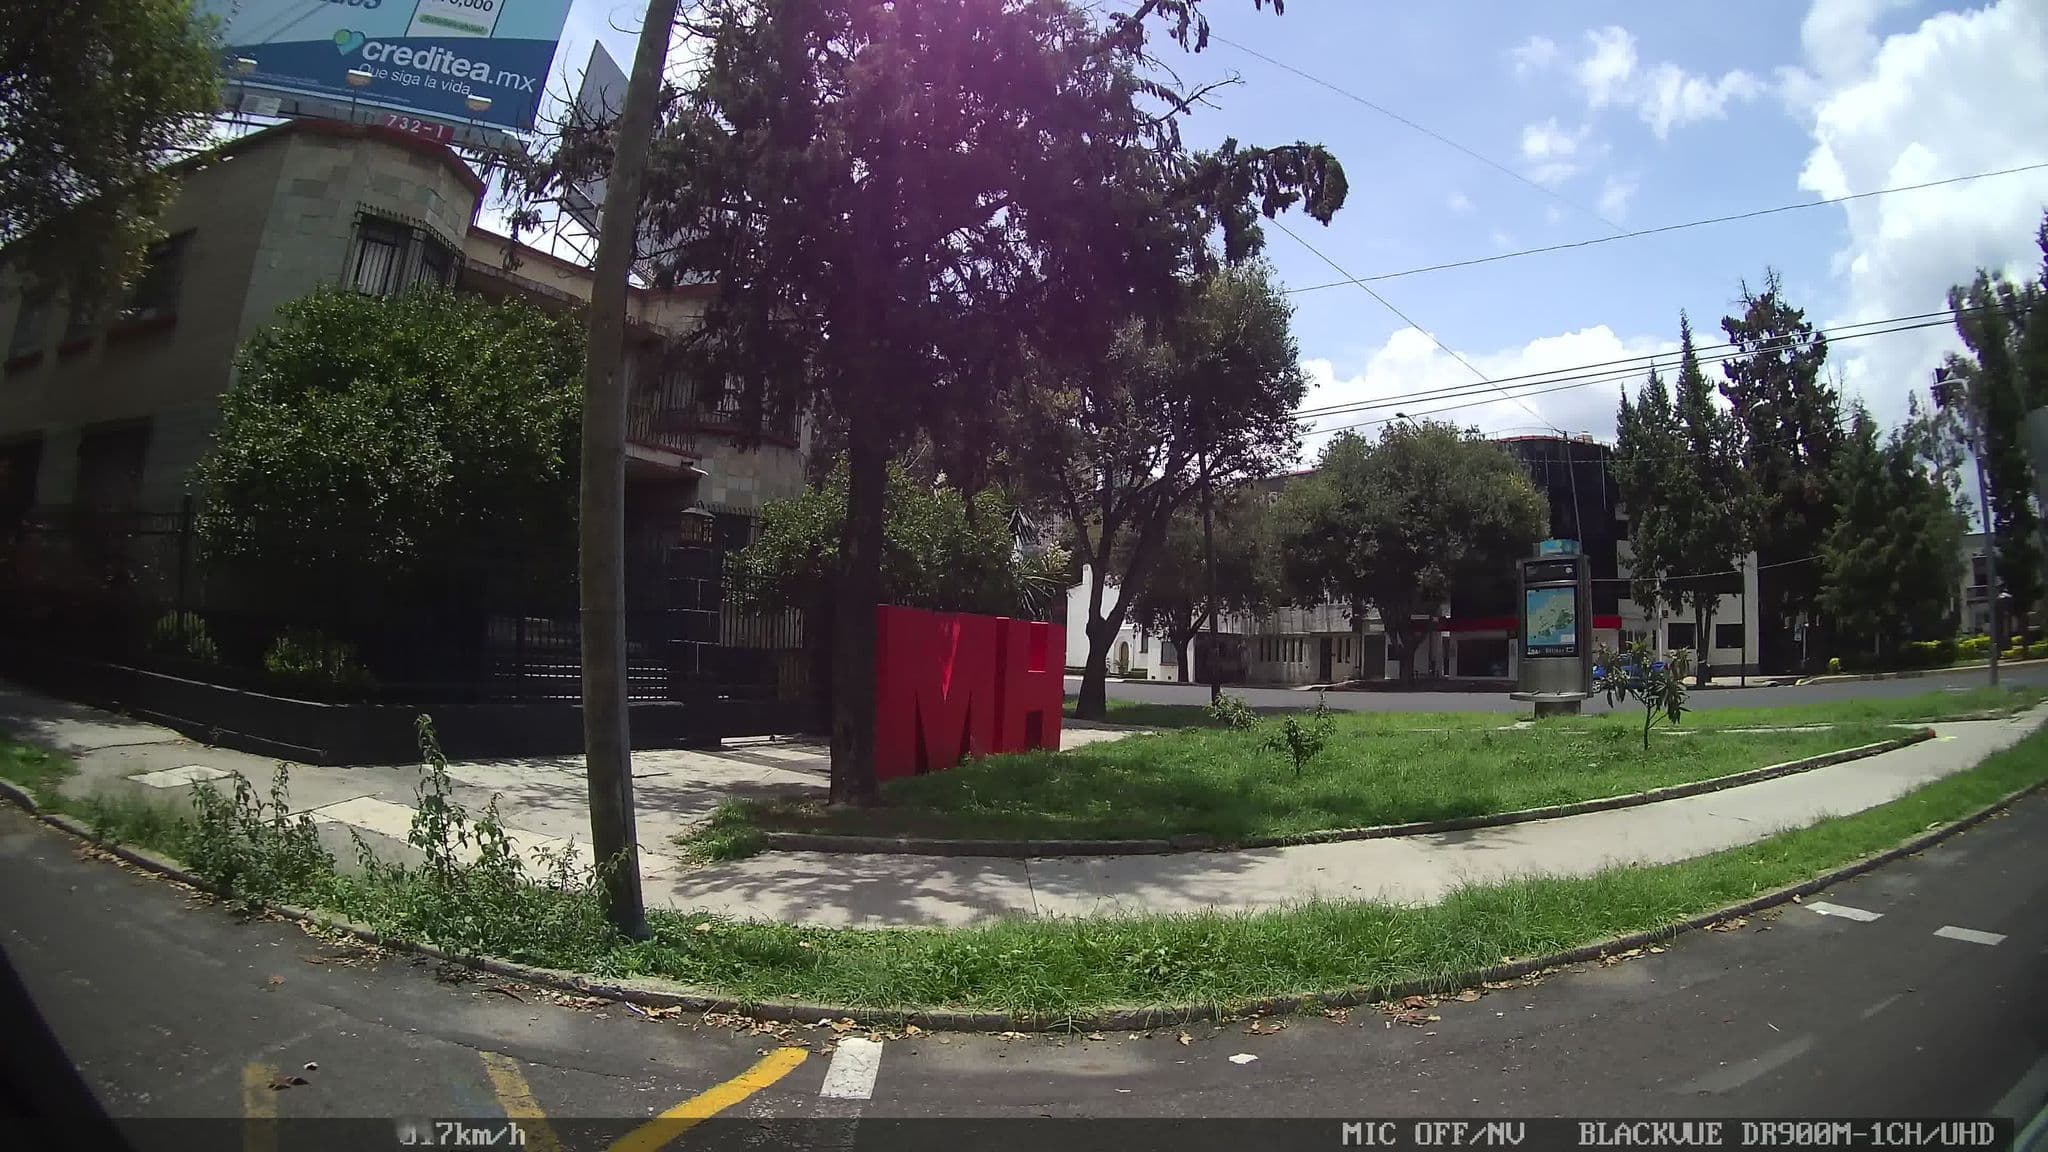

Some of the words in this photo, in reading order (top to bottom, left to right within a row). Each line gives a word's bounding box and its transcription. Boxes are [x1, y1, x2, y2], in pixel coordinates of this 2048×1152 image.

[361, 40, 536, 93] creditea.mx
[391, 69, 420, 86] siga
[424, 75, 437, 89] la
[387, 114, 445, 139] 732-1
[876, 604, 1065, 781] MH
